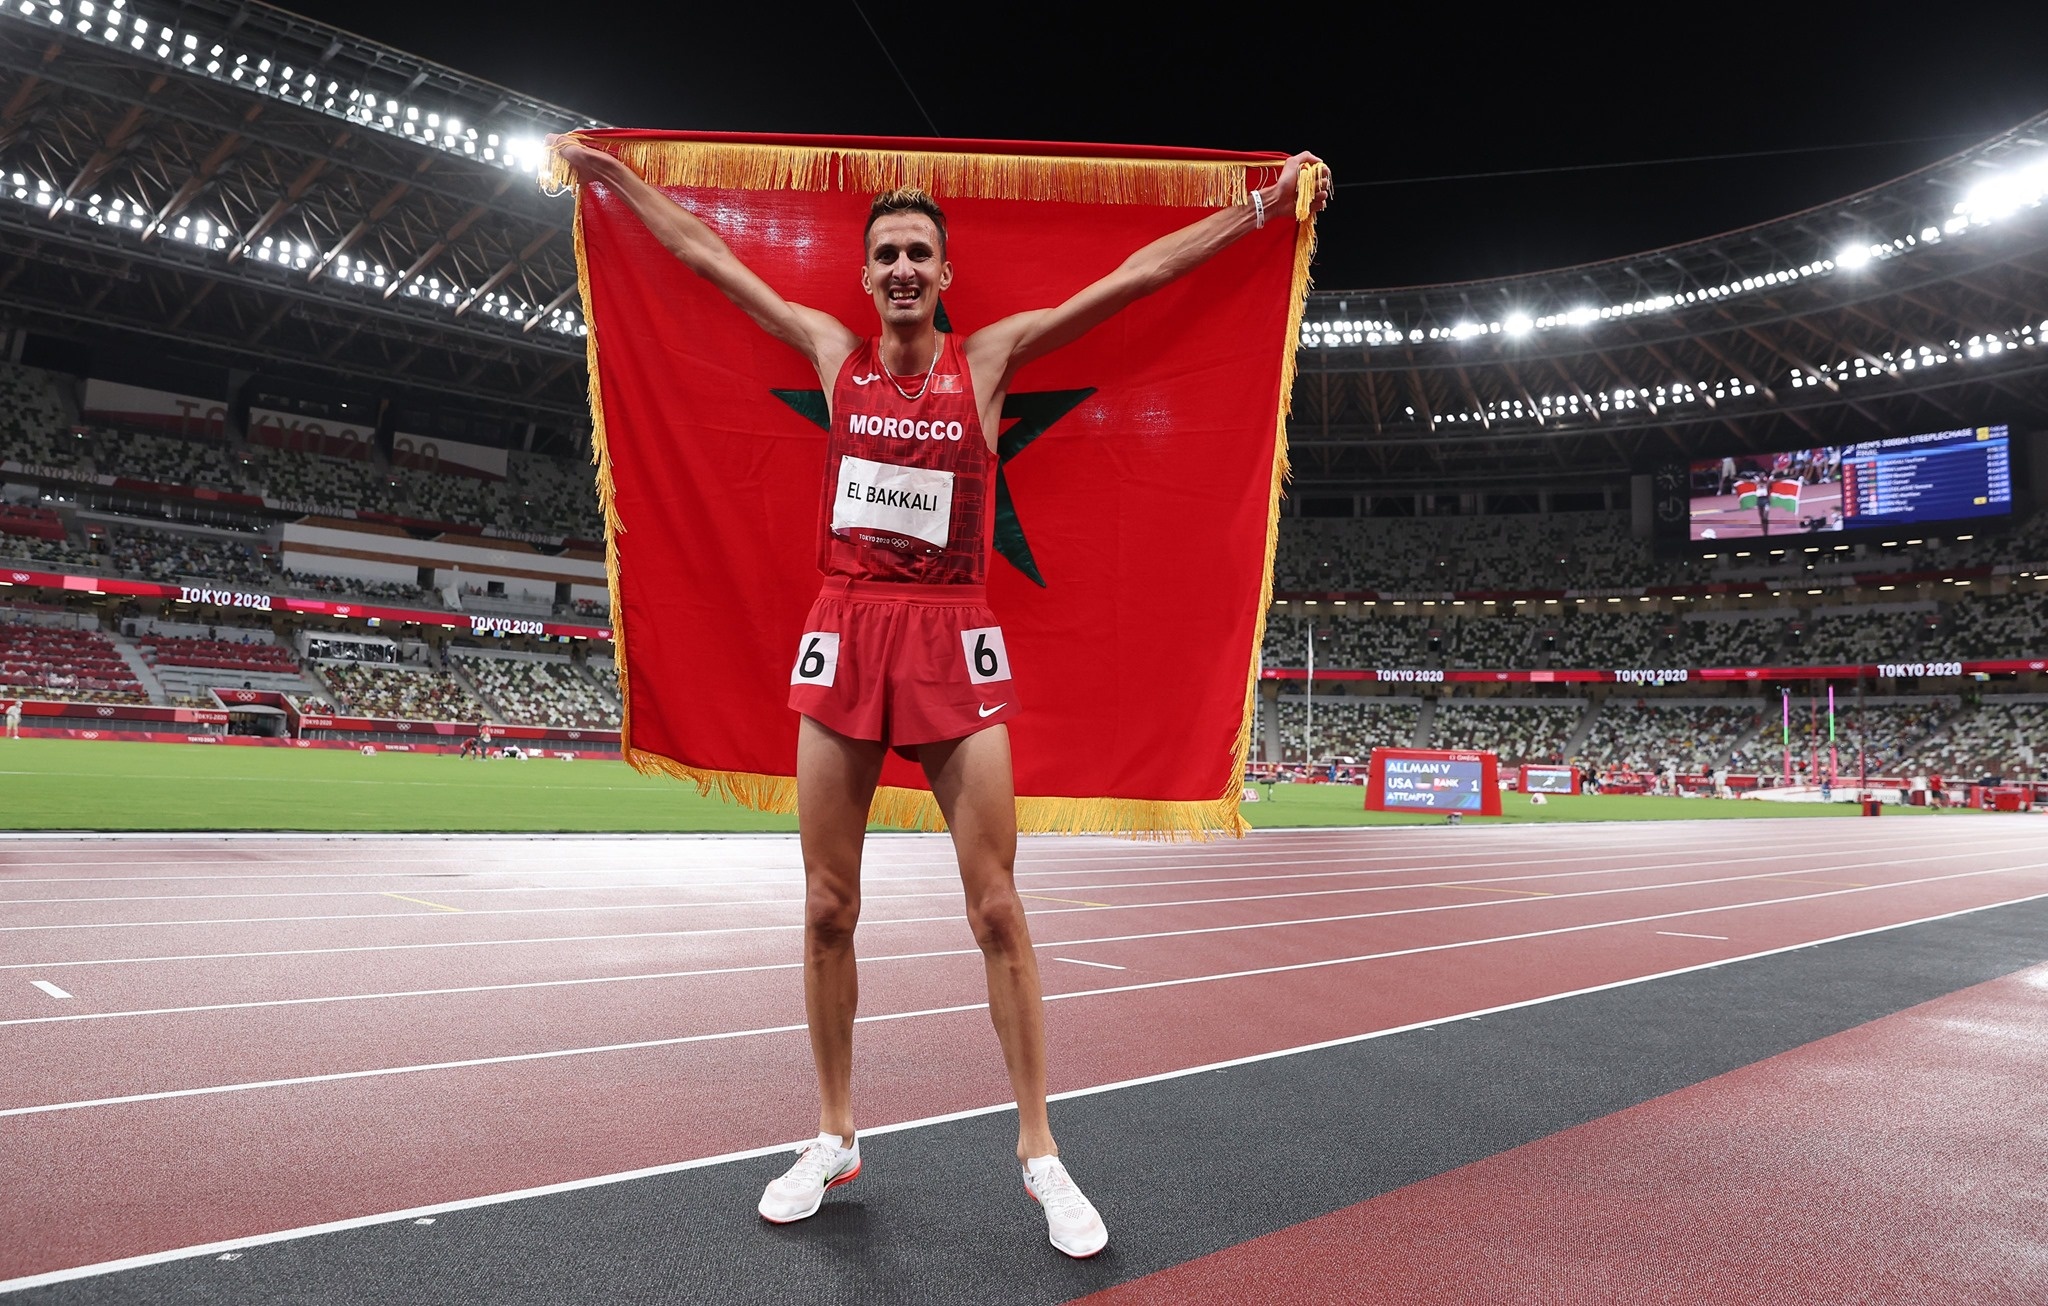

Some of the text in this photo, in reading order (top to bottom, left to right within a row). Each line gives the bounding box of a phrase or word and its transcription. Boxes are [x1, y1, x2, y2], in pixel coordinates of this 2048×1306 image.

[175, 400, 326, 453] TOKYO
[849, 414, 963, 441] MOROCCO
[1909, 428, 1973, 443] STEEPLECHASE
[22, 464, 100, 484] TOKYO 2020
[847, 482, 938, 511] EL BAKKALI
[859, 533, 876, 543] TOKYO
[180, 586, 271, 609] TOKYO 2020
[470, 615, 544, 635] TOKYO 2020
[799, 637, 825, 678] 6
[974, 633, 998, 677] 6
[1376, 670, 1444, 682] TOKYO 2020
[1614, 669, 1688, 683] TOKYO 2020
[1877, 662, 1962, 678] TOKYO 2020
[1387, 761, 1451, 774] ALLMAN V
[1388, 777, 1479, 793] USA RANK 1
[1386, 793, 1435, 806] ATTEMPT 2
